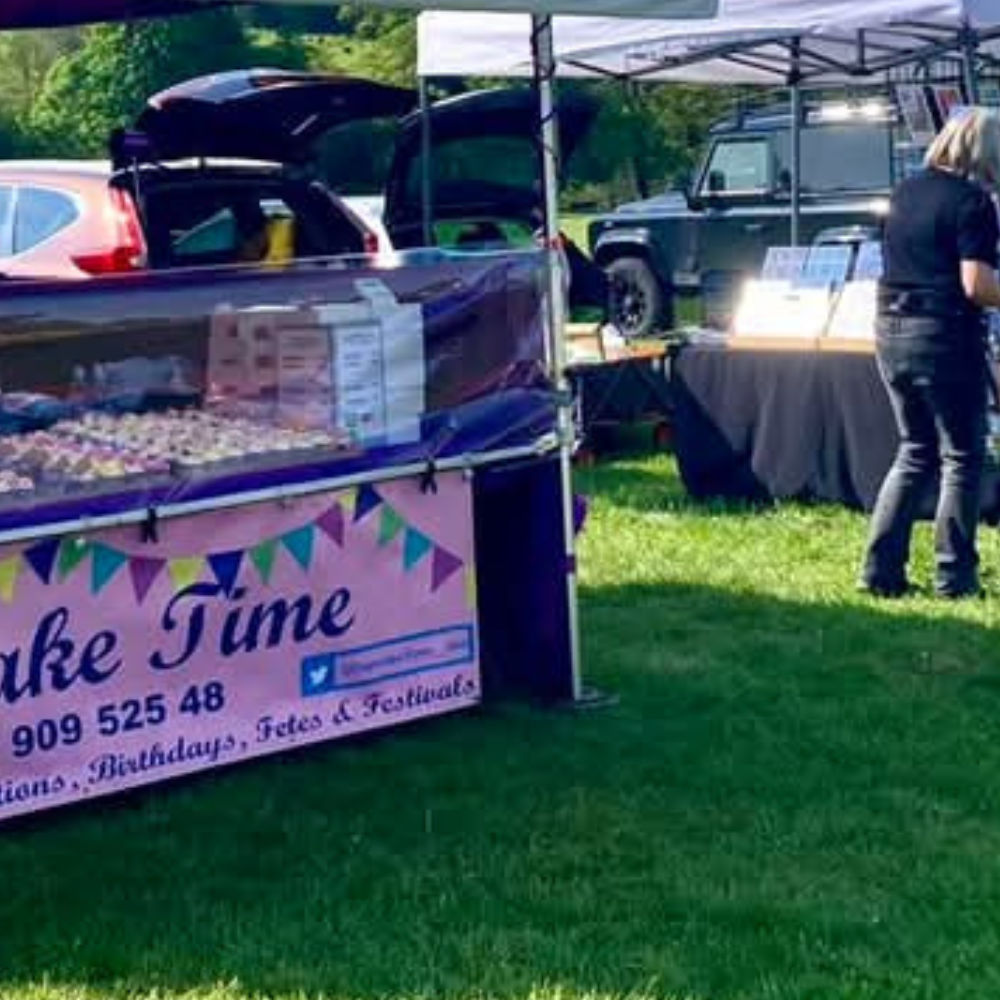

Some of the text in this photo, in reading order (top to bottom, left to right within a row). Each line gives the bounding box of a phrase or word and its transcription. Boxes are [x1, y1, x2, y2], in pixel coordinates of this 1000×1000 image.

[150, 581, 355, 670] Time
[12, 713, 82, 757] 909
[97, 694, 166, 736] 525
[180, 682, 224, 714] 48
[88, 735, 247, 784] Birthdays,
[256, 714, 323, 744] Fetes
[332, 704, 353, 727] &
[363, 674, 475, 722] Festivals
